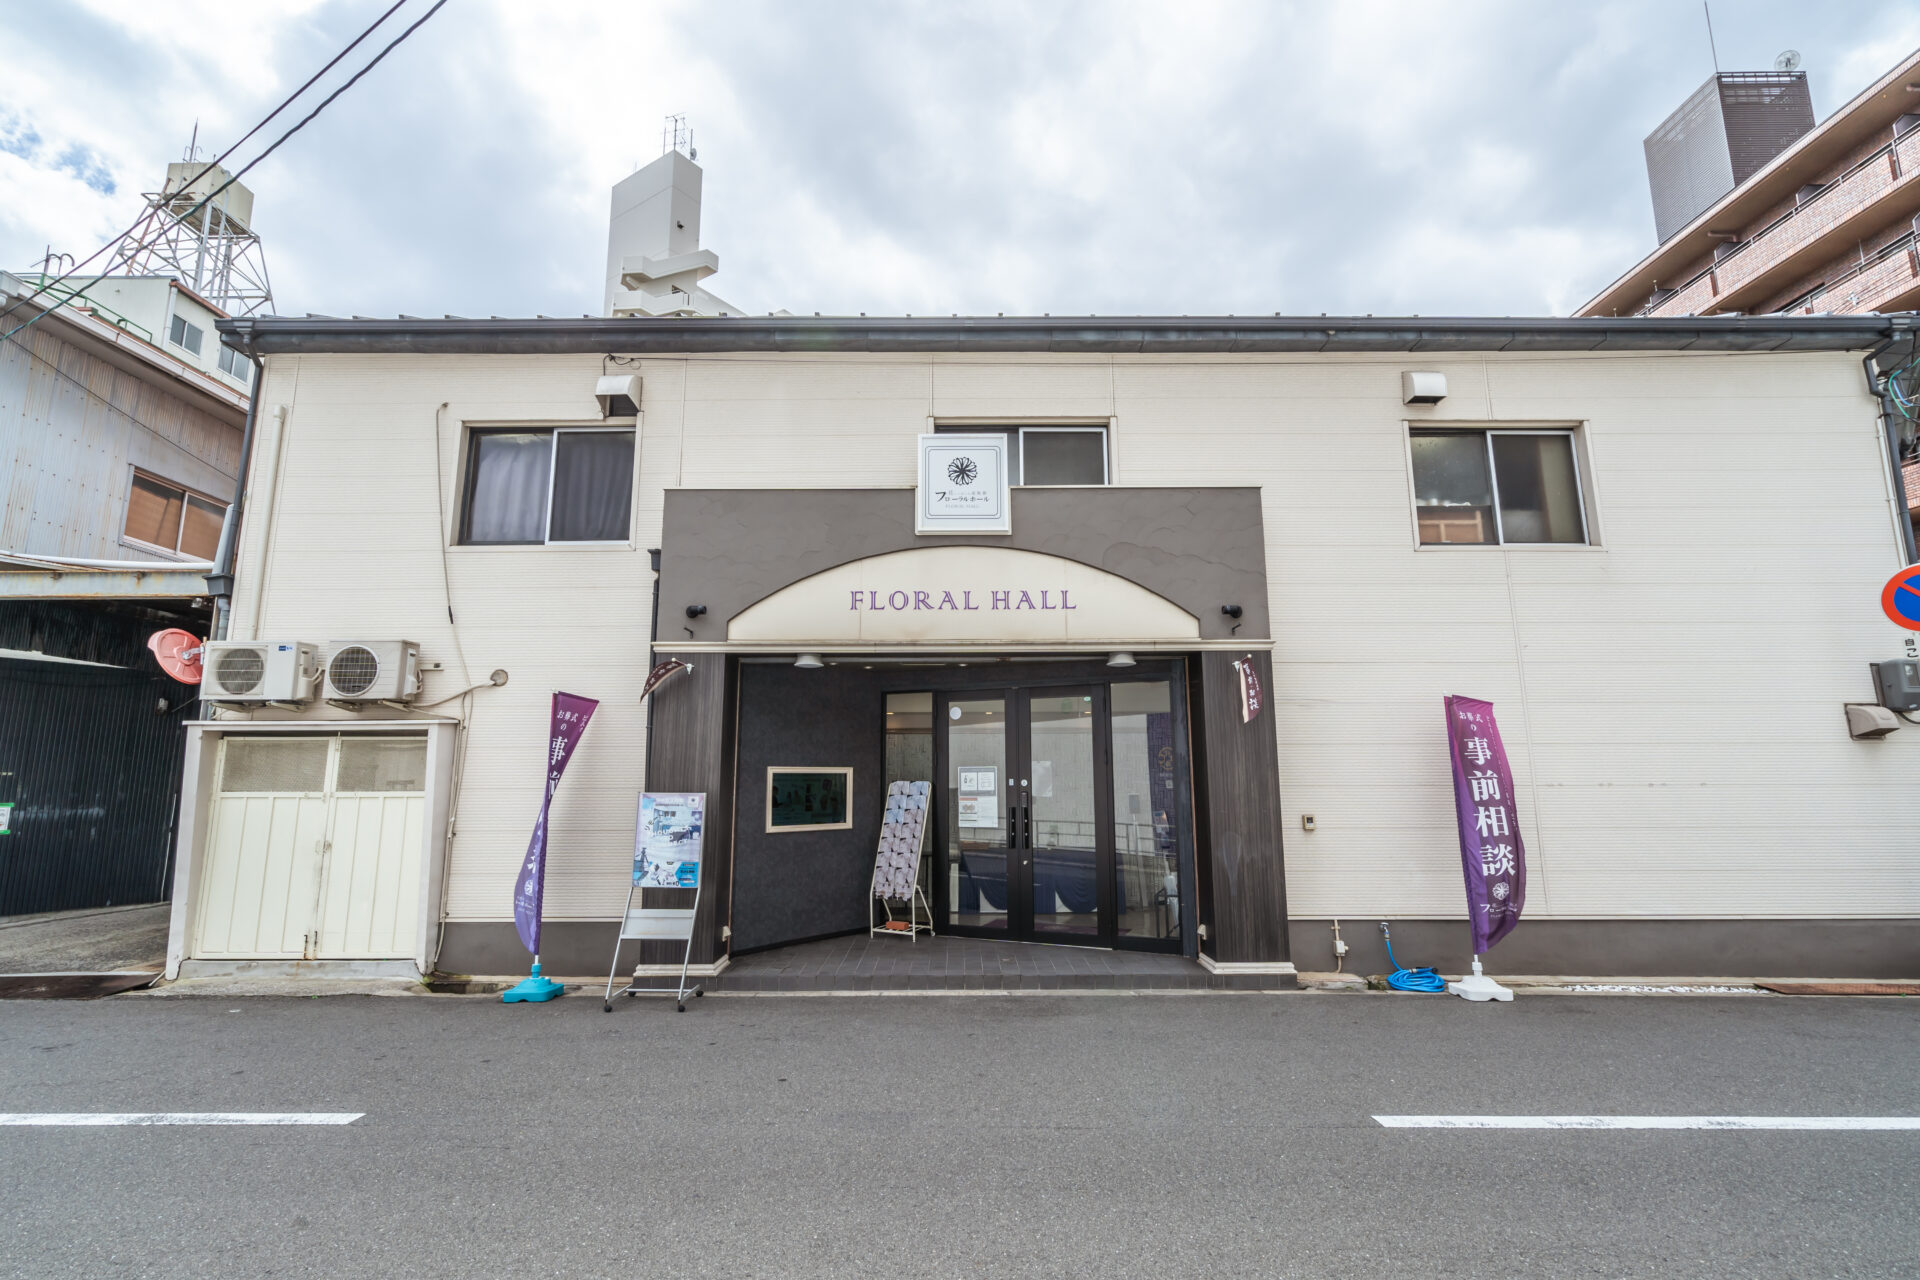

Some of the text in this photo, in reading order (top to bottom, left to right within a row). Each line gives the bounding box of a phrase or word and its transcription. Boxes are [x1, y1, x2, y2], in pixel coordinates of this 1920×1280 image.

[935, 491, 989, 503] フローラルホール
[850, 589, 1077, 611] FLORAL HALL
[1463, 736, 1516, 876] 事前相談
